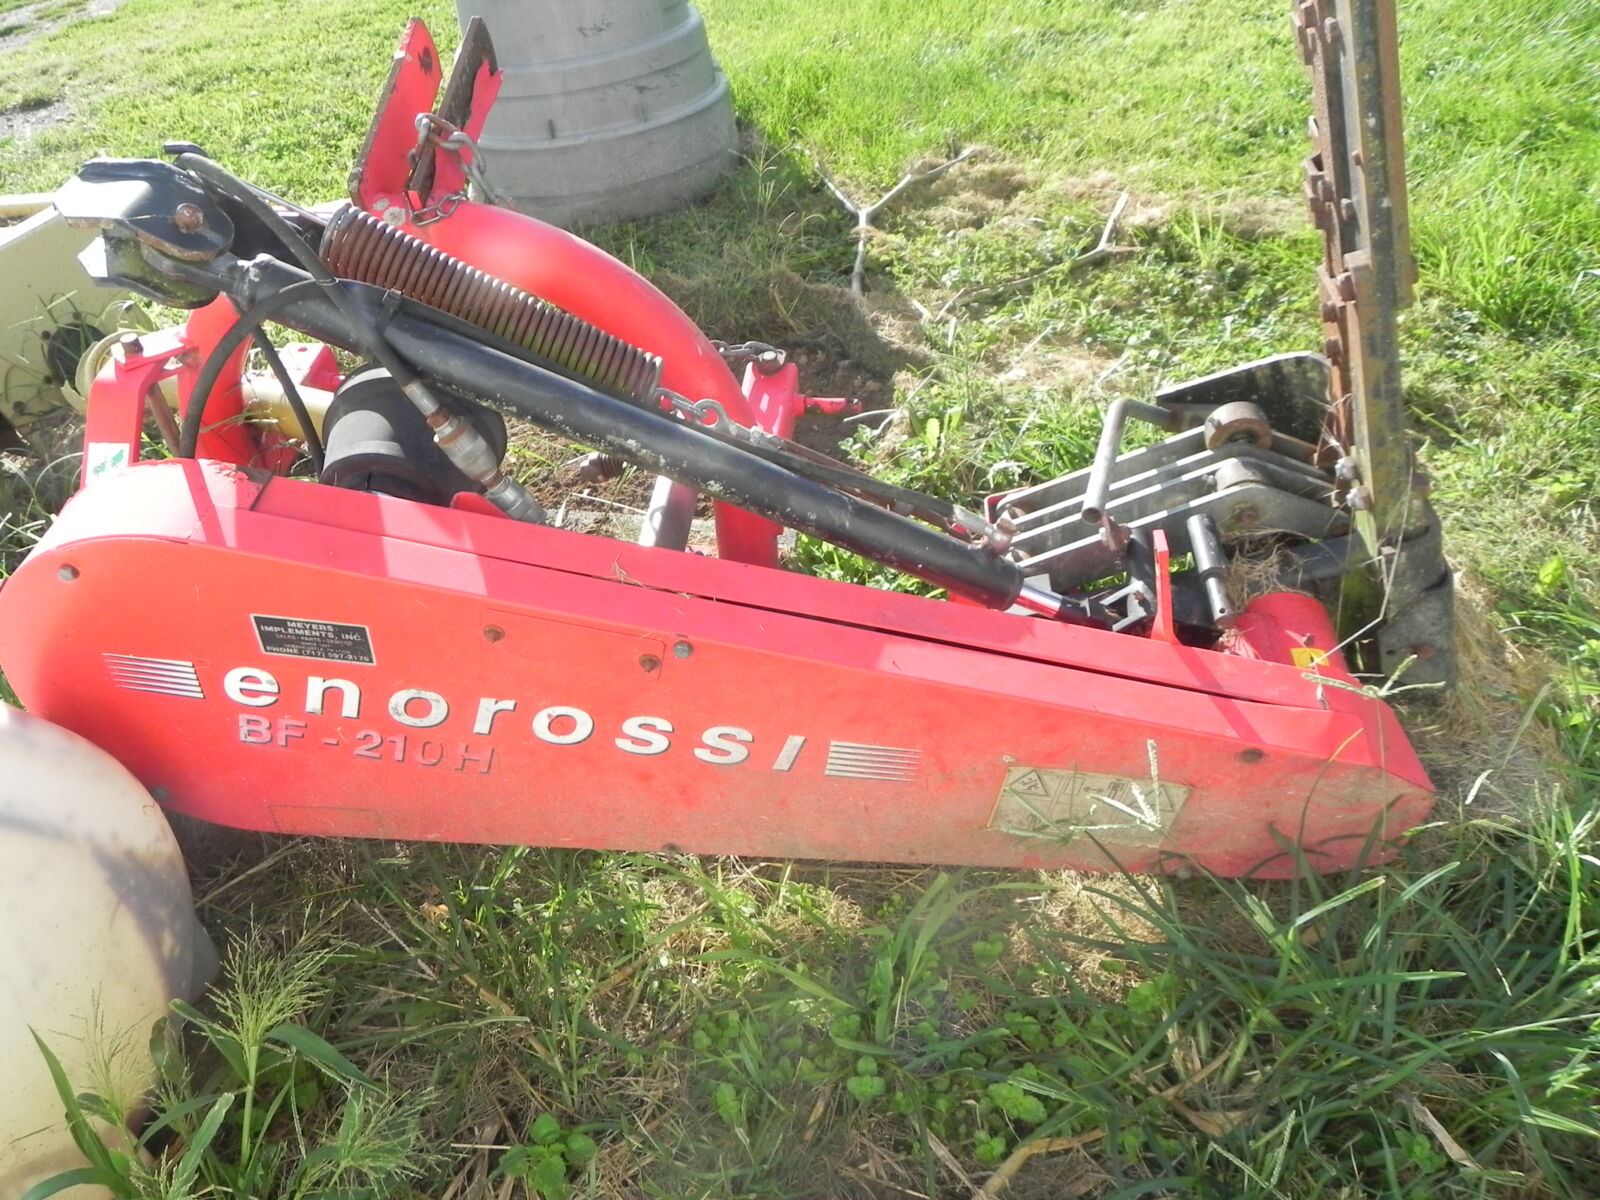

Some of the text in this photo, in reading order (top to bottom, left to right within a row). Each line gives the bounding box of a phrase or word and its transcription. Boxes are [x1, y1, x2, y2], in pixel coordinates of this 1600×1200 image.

[286, 620, 334, 631] MEYERS
[260, 624, 338, 640] IMPLEMENTS,
[266, 645, 300, 654] PHONE
[301, 649, 326, 657] (717)
